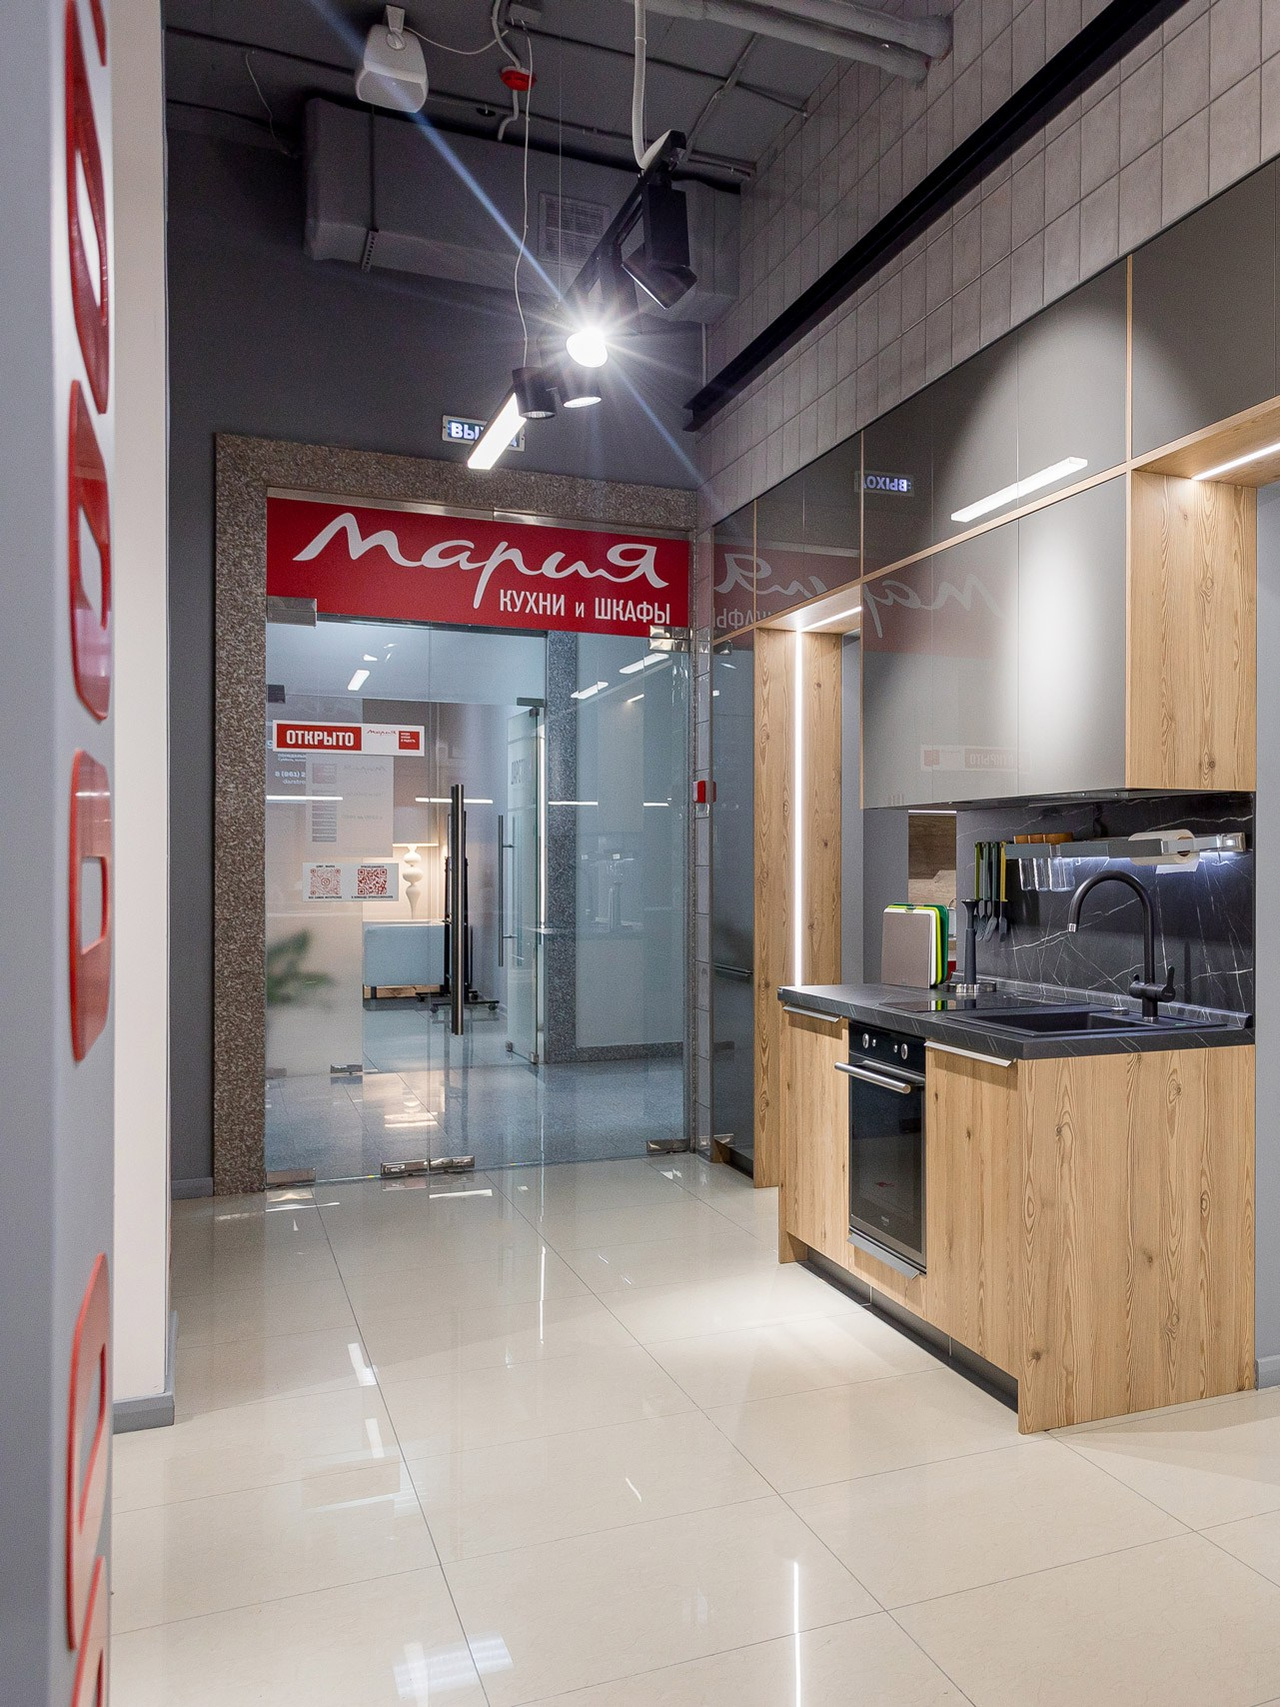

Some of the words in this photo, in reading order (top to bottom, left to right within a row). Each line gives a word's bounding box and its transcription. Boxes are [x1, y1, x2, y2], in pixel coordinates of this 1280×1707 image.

[500, 589, 566, 617] КУХНИ
[595, 597, 671, 625] ШКАФЫ
[286, 729, 355, 747] ОТКРЫТО
